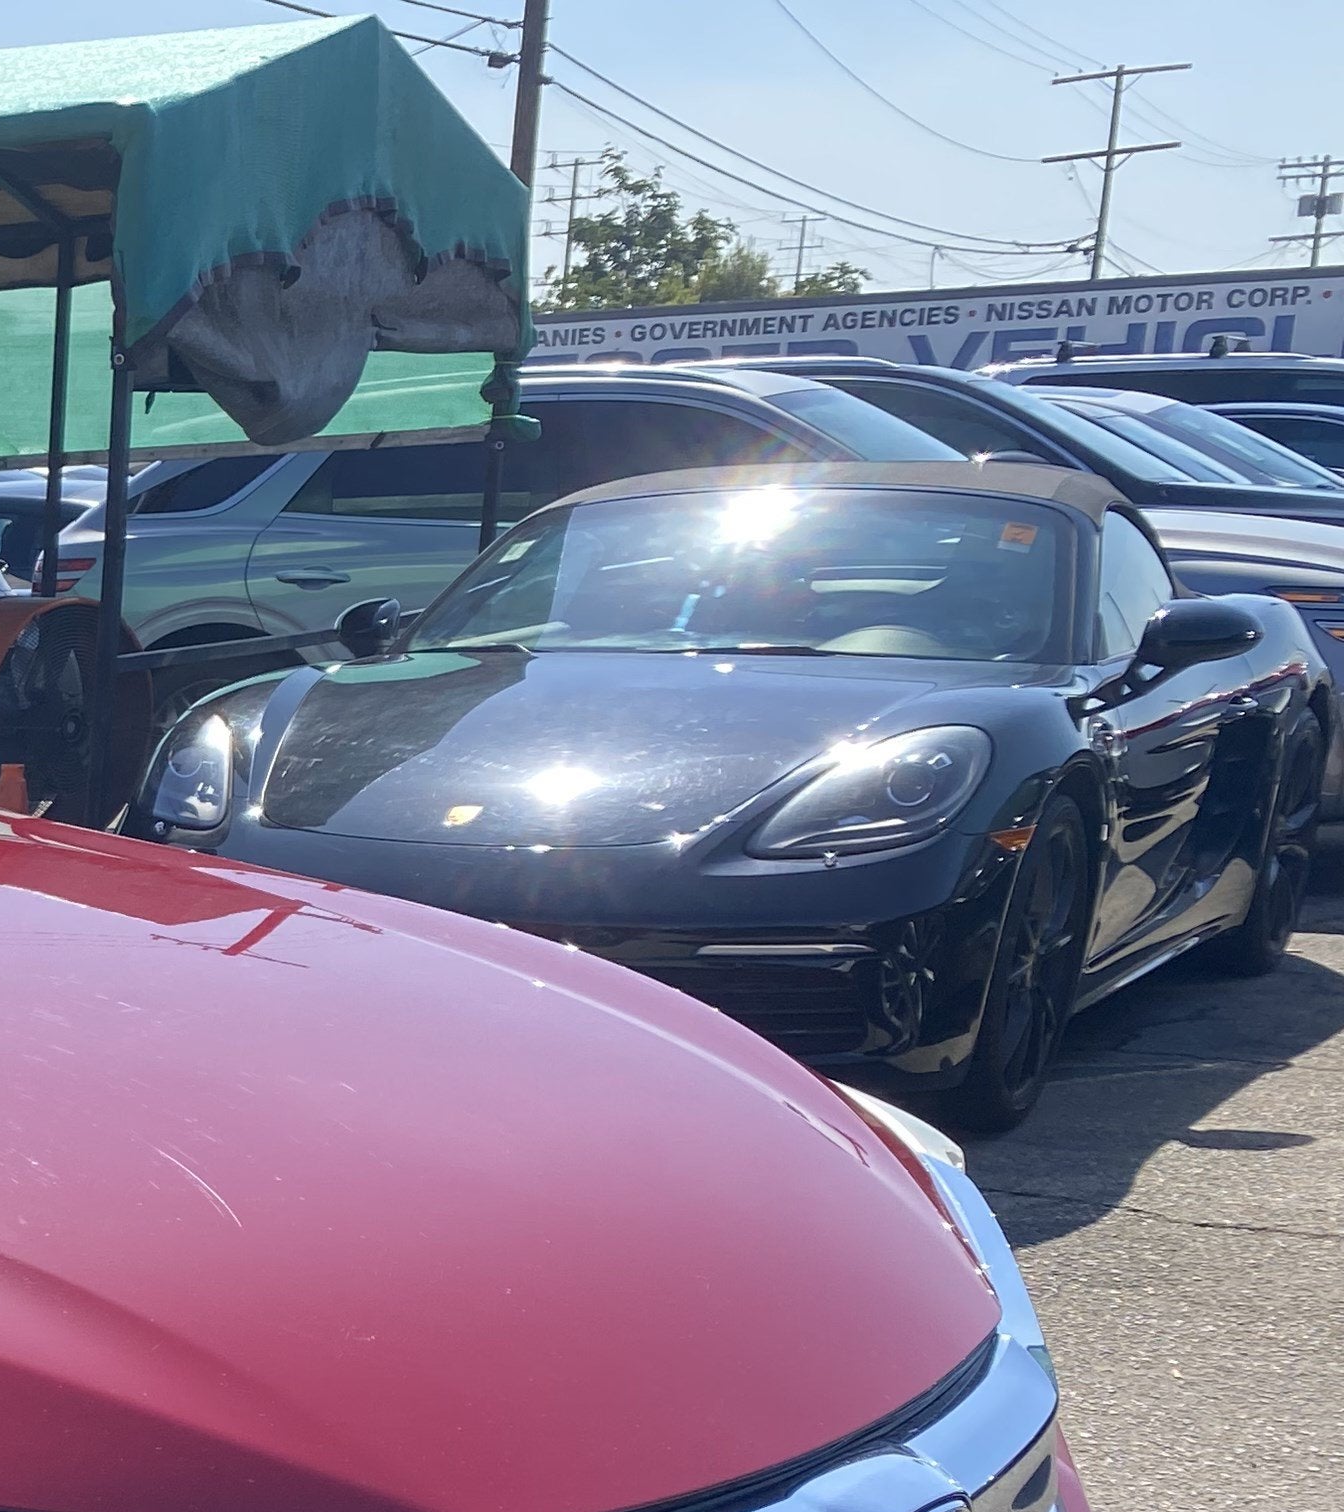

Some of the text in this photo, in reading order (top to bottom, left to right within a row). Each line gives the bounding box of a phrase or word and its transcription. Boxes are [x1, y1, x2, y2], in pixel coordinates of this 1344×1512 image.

[630, 314, 814, 342] GOVERNMENT
[822, 305, 961, 332] AGENCIES
[984, 297, 1098, 322] NISSAN
[1106, 290, 1215, 316] MOTOR
[1226, 285, 1312, 309] CORP.
